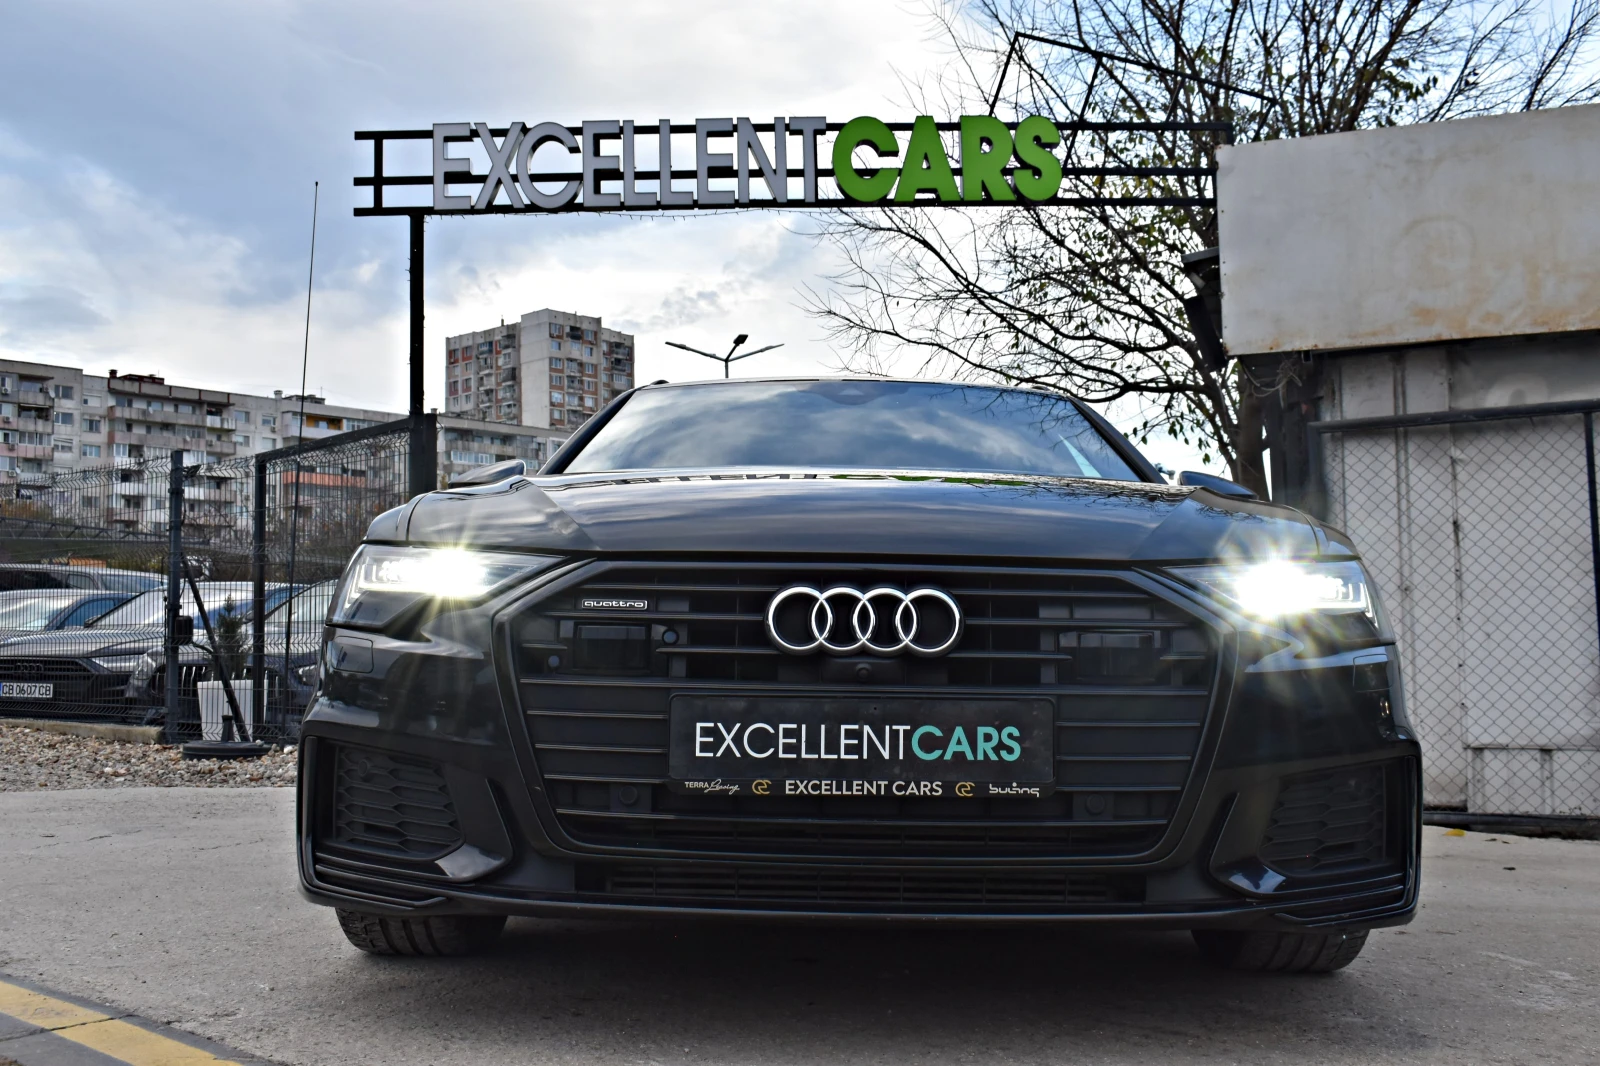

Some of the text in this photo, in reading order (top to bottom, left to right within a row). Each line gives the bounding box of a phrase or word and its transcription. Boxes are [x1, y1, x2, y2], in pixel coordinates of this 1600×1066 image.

[695, 721, 1022, 761] EXCELLENTCARS
[684, 781, 709, 789] TERRA
[785, 779, 888, 796] EXCELLENT
[891, 780, 943, 797] CARS
